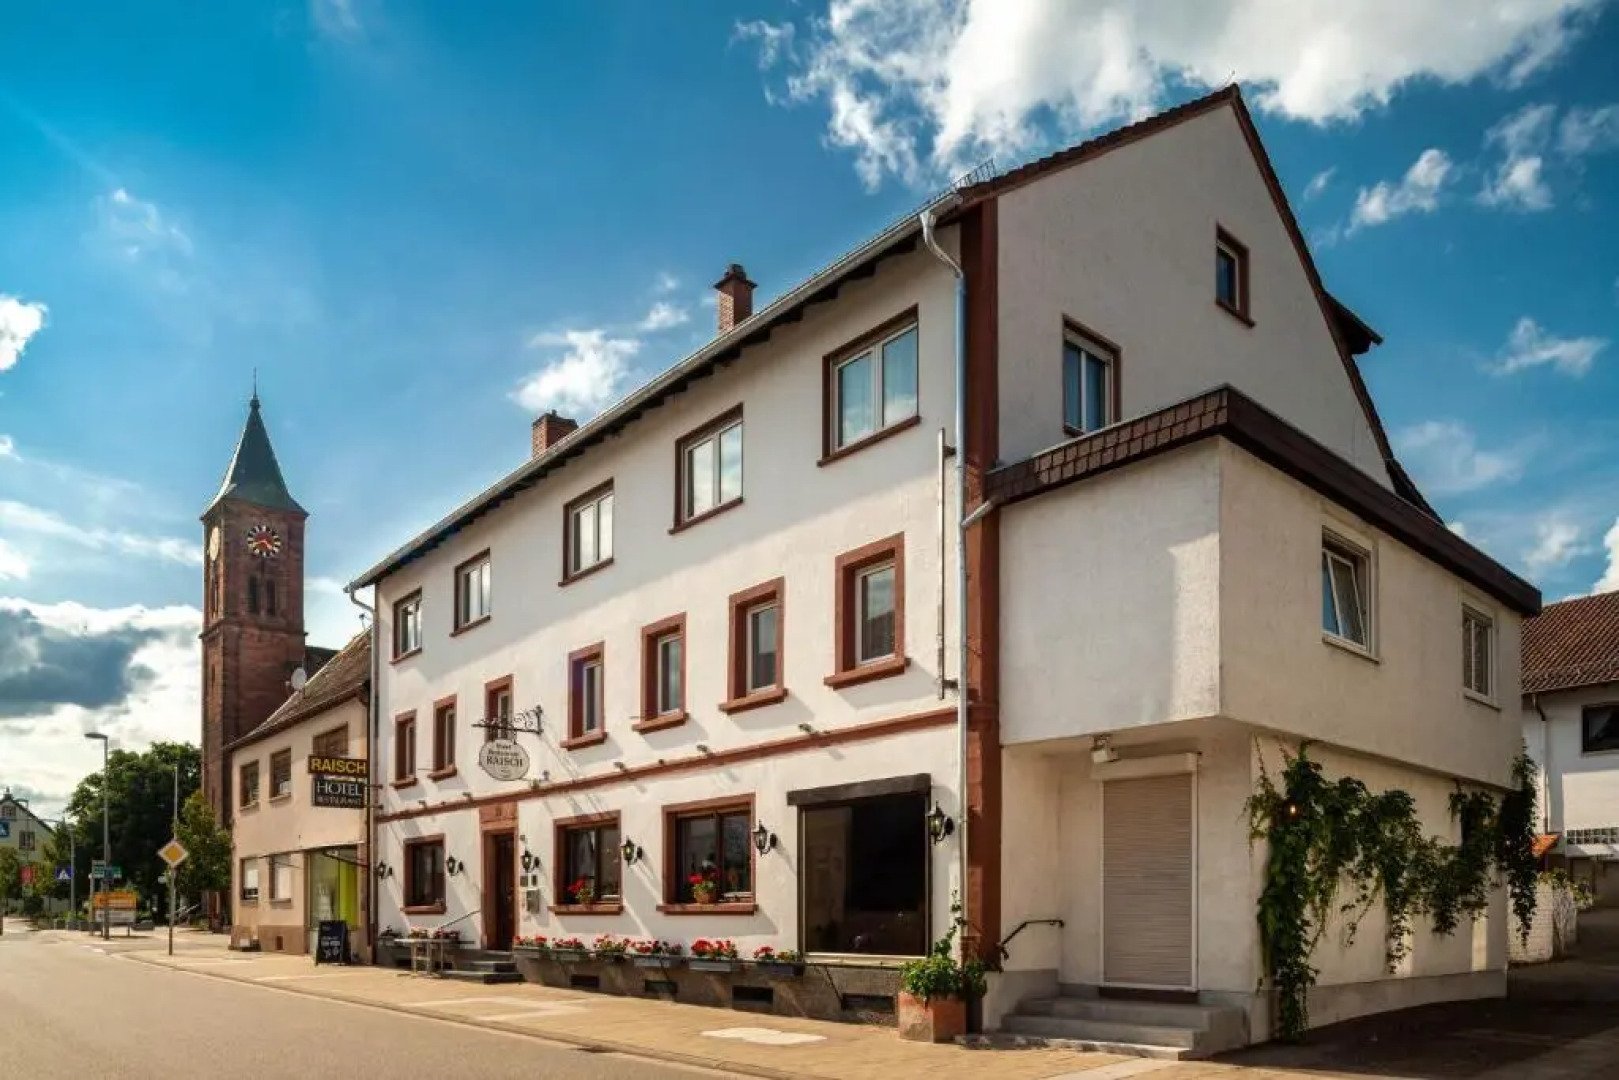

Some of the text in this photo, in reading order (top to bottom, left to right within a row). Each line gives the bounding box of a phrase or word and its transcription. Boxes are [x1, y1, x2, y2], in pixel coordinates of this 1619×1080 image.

[310, 758, 367, 774] RAISCH
[486, 755, 523, 768] RAISCH
[316, 780, 363, 797] HOTEL
